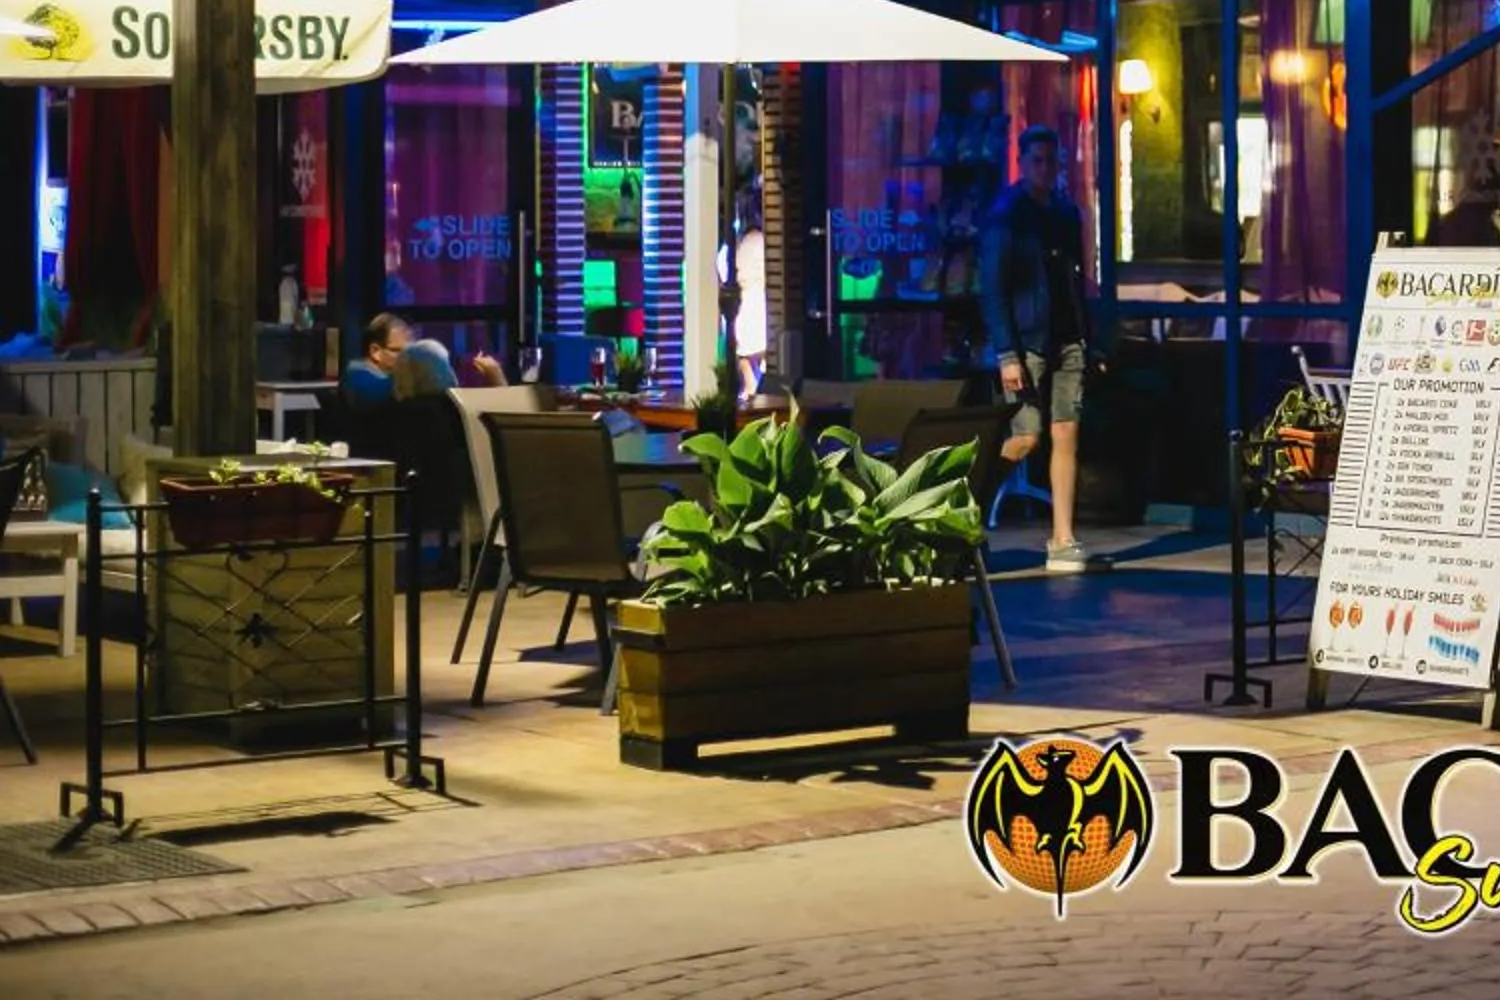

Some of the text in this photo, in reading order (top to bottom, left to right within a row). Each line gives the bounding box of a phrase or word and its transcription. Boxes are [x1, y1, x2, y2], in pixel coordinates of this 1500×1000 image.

[443, 214, 510, 236] SLIDE
[408, 238, 511, 260] TO OPEN
[1400, 266, 1500, 298] BACARDÍ
[1393, 377, 1485, 394] OUR PROMOTION
[1384, 585, 1425, 601] HOLIDAY
[1427, 591, 1465, 606] SMILES
